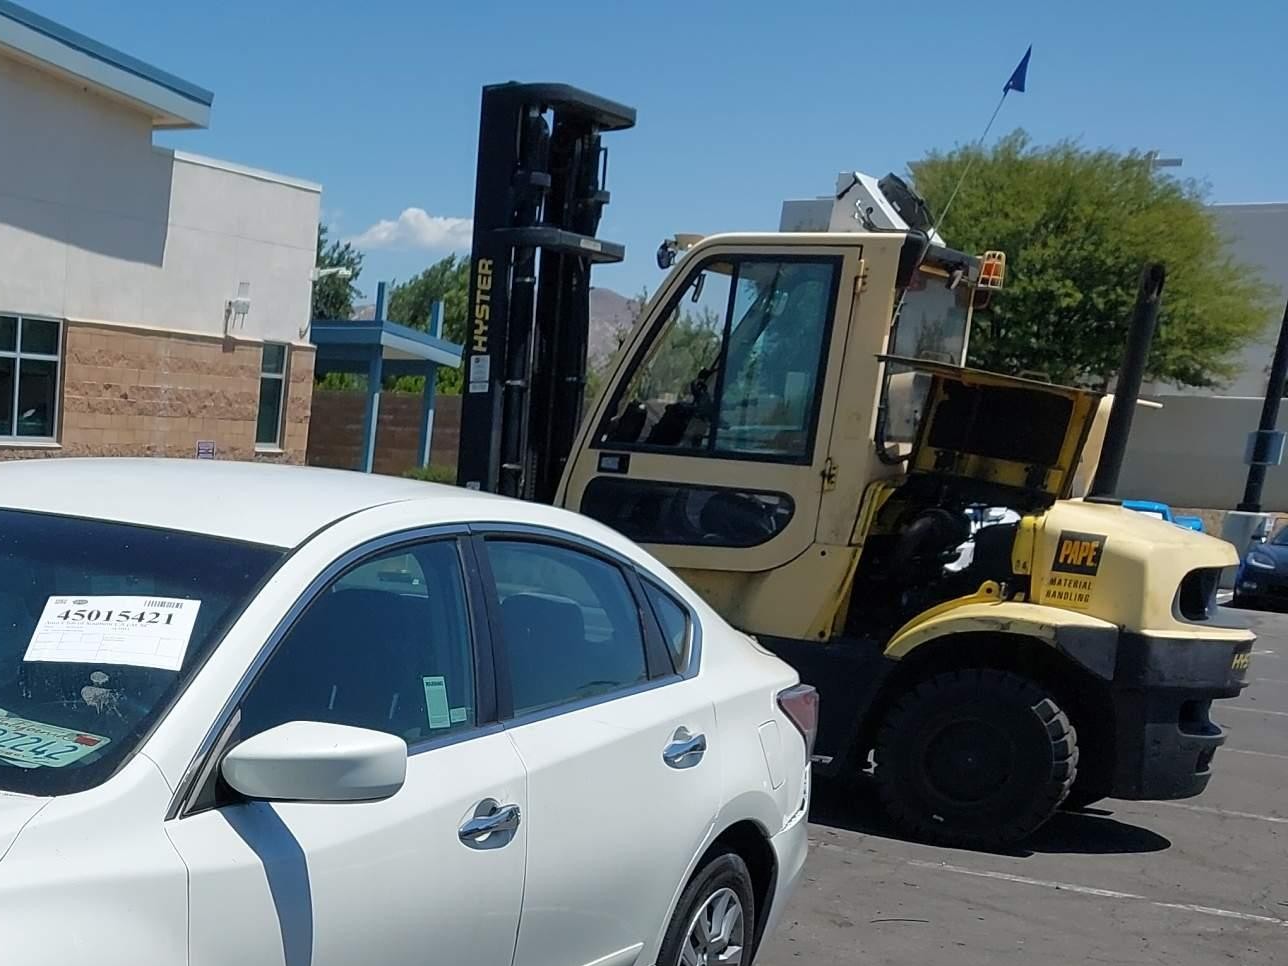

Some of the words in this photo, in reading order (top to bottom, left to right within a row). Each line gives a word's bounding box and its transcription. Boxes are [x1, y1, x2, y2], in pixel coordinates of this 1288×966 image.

[472, 258, 493, 352] HYSTER
[1049, 576, 1092, 591] MATERIAL
[1045, 589, 1091, 603] HANDLING
[56, 609, 174, 625] 45015421
